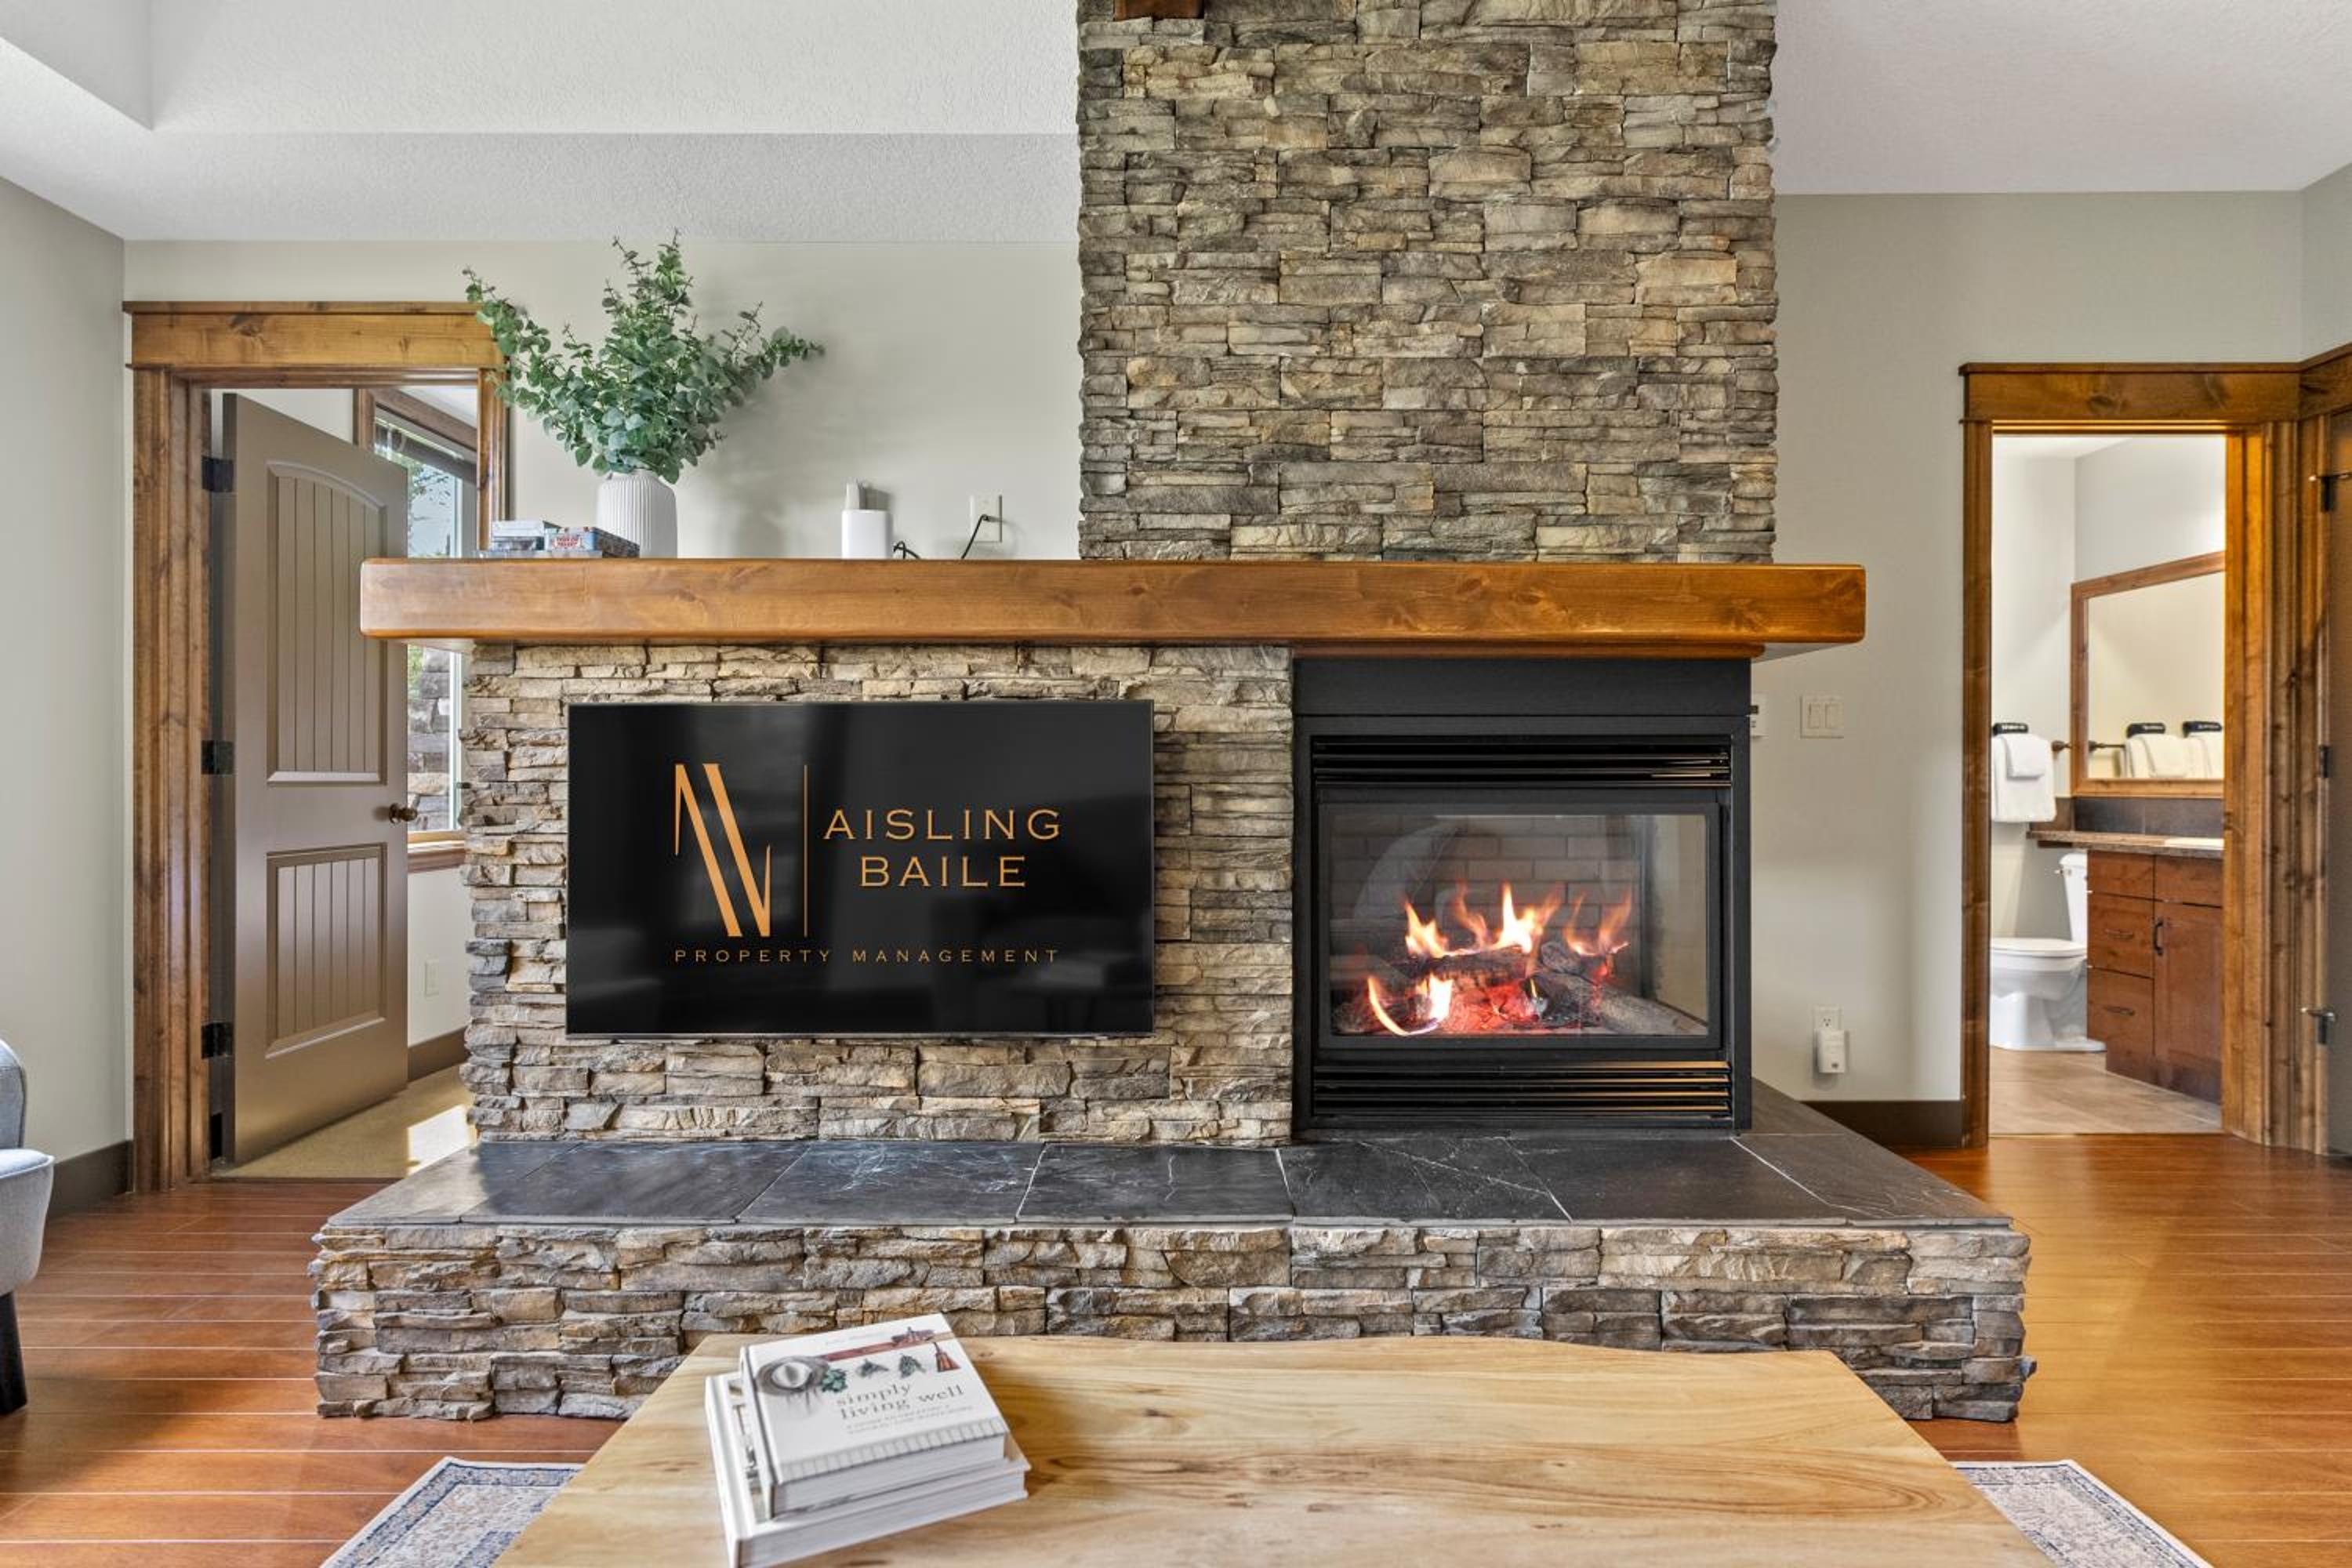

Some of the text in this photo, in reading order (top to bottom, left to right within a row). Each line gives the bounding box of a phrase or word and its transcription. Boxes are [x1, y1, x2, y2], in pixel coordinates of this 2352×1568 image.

[825, 808, 1061, 840] AISLING
[860, 856, 1026, 887] BAILE
[675, 949, 1059, 963] PROPERTY MANAGEMENT
[837, 1383, 911, 1406] simply
[841, 1399, 910, 1420] living
[918, 1384, 964, 1403] well
